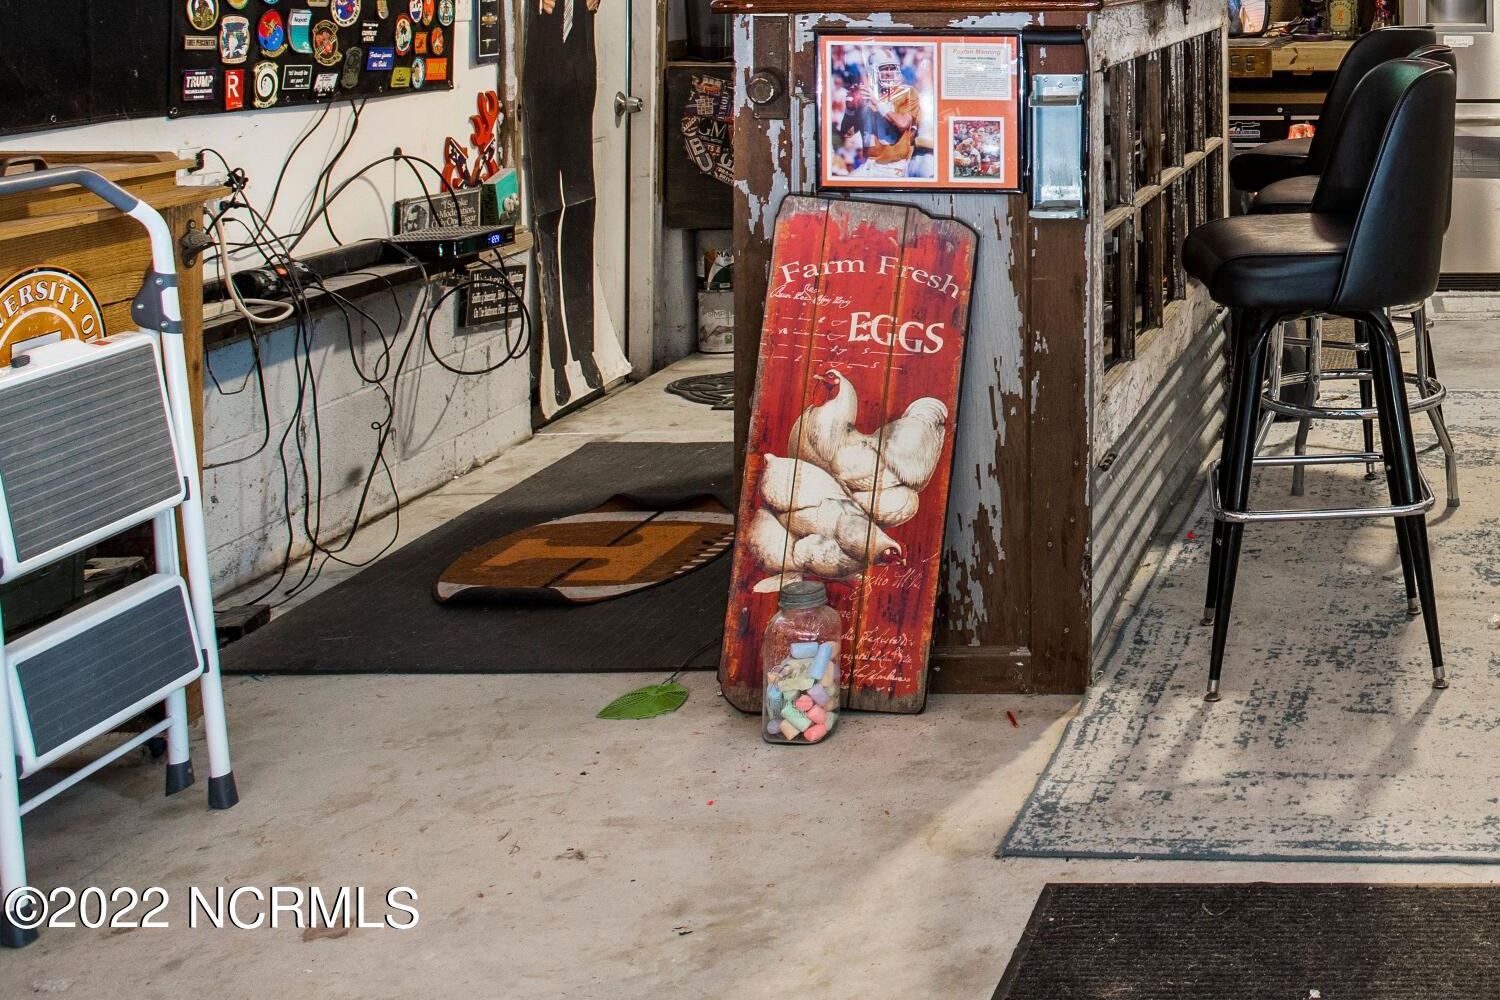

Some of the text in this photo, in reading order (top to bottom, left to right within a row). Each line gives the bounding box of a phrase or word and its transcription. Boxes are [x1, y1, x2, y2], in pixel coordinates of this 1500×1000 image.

[974, 48, 1002, 56] Manning
[185, 75, 214, 89] TRUMP
[226, 74, 239, 98] R
[698, 119, 727, 141] GM
[779, 255, 865, 284] Farm
[876, 255, 960, 299] Fresh
[0, 280, 85, 329] ERSITY
[848, 310, 945, 354] EGGS
